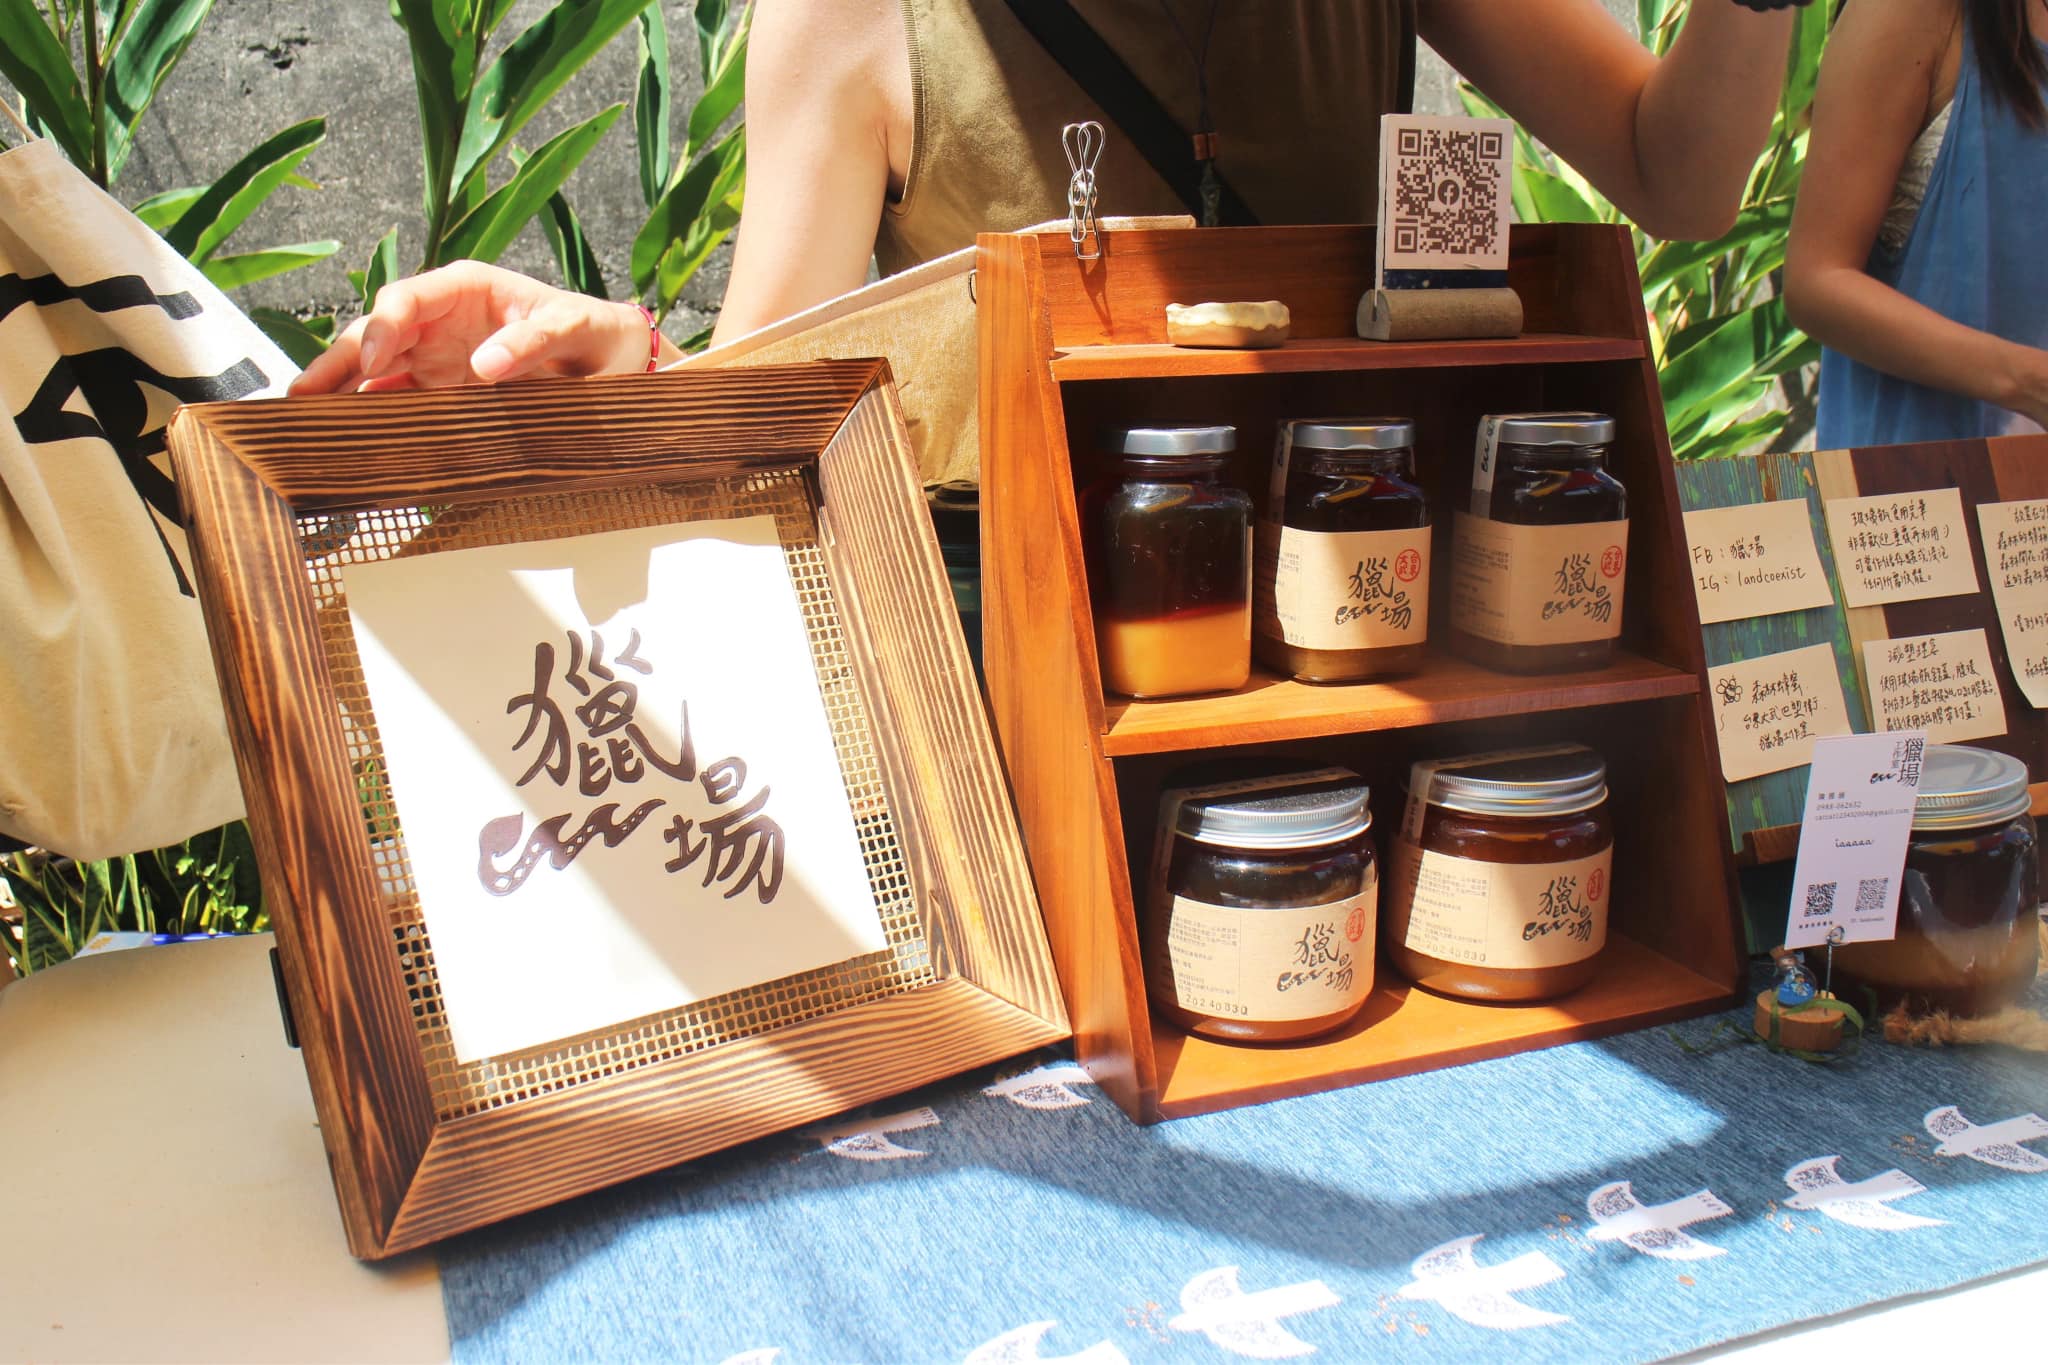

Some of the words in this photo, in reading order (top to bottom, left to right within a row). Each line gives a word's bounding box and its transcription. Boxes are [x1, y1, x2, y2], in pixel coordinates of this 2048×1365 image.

[1738, 567, 1806, 587] landcoexist
[506, 627, 787, 905] 獵場
[1897, 738, 1924, 787] 獵場
